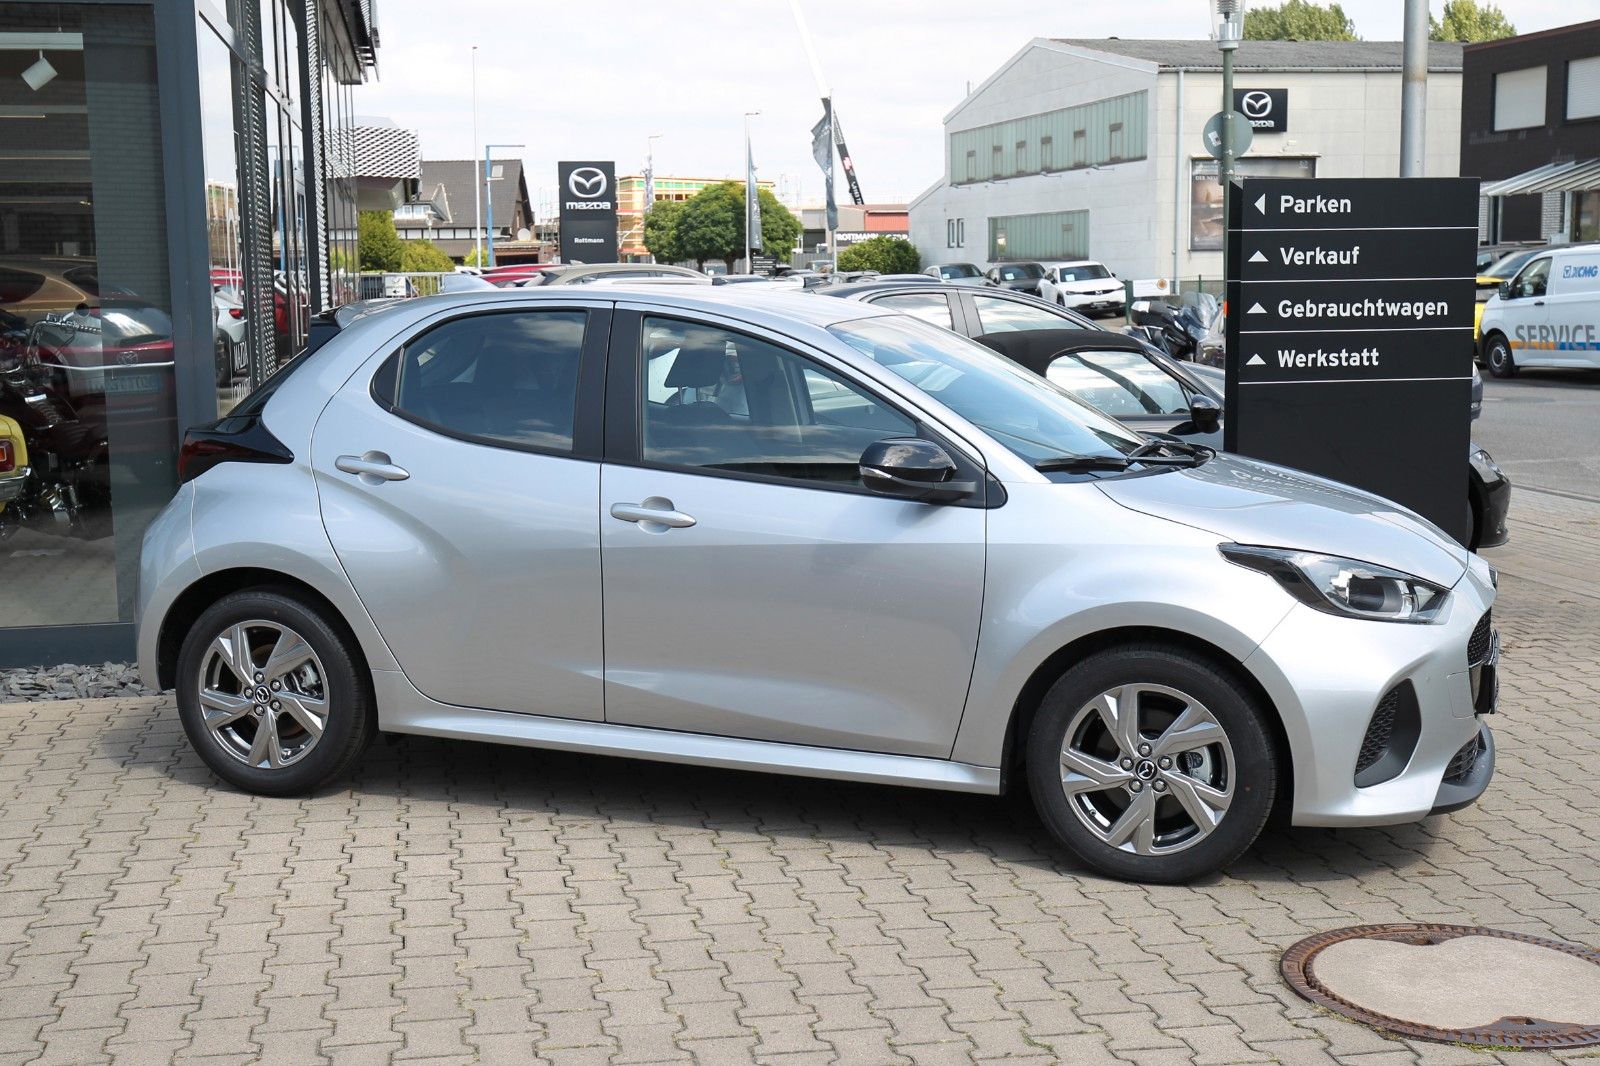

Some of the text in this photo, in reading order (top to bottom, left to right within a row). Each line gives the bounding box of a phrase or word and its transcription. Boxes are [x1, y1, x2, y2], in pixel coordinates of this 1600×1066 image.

[566, 201, 611, 210] mazda
[1280, 195, 1352, 214] Parken
[1280, 247, 1360, 265] Verkauf
[1278, 299, 1449, 320] Gebrauchtwagen
[1515, 324, 1595, 350] SERVICE
[1277, 348, 1379, 368] Werkstatt
